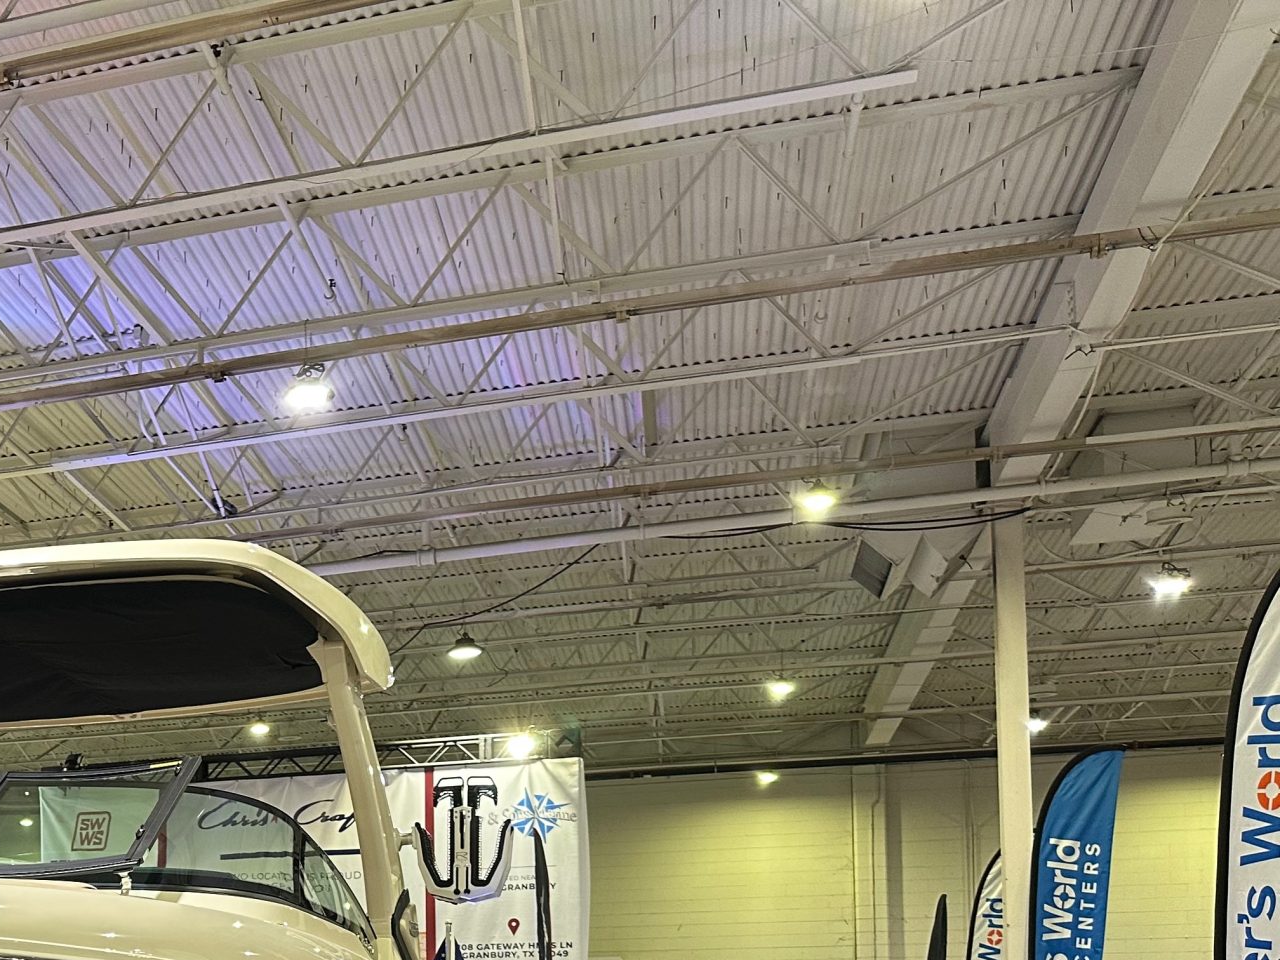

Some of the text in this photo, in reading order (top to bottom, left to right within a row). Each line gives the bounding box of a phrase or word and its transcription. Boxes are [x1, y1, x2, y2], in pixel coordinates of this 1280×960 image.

[1240, 696, 1280, 866] World
[293, 799, 355, 832] Craf
[79, 817, 106, 831] SW
[79, 831, 105, 846] WS
[1042, 838, 1081, 940] World
[461, 943, 474, 951] 08
[476, 942, 525, 951] GATEWAY
[560, 941, 573, 949] LN
[462, 951, 520, 959] GRANBURY,
